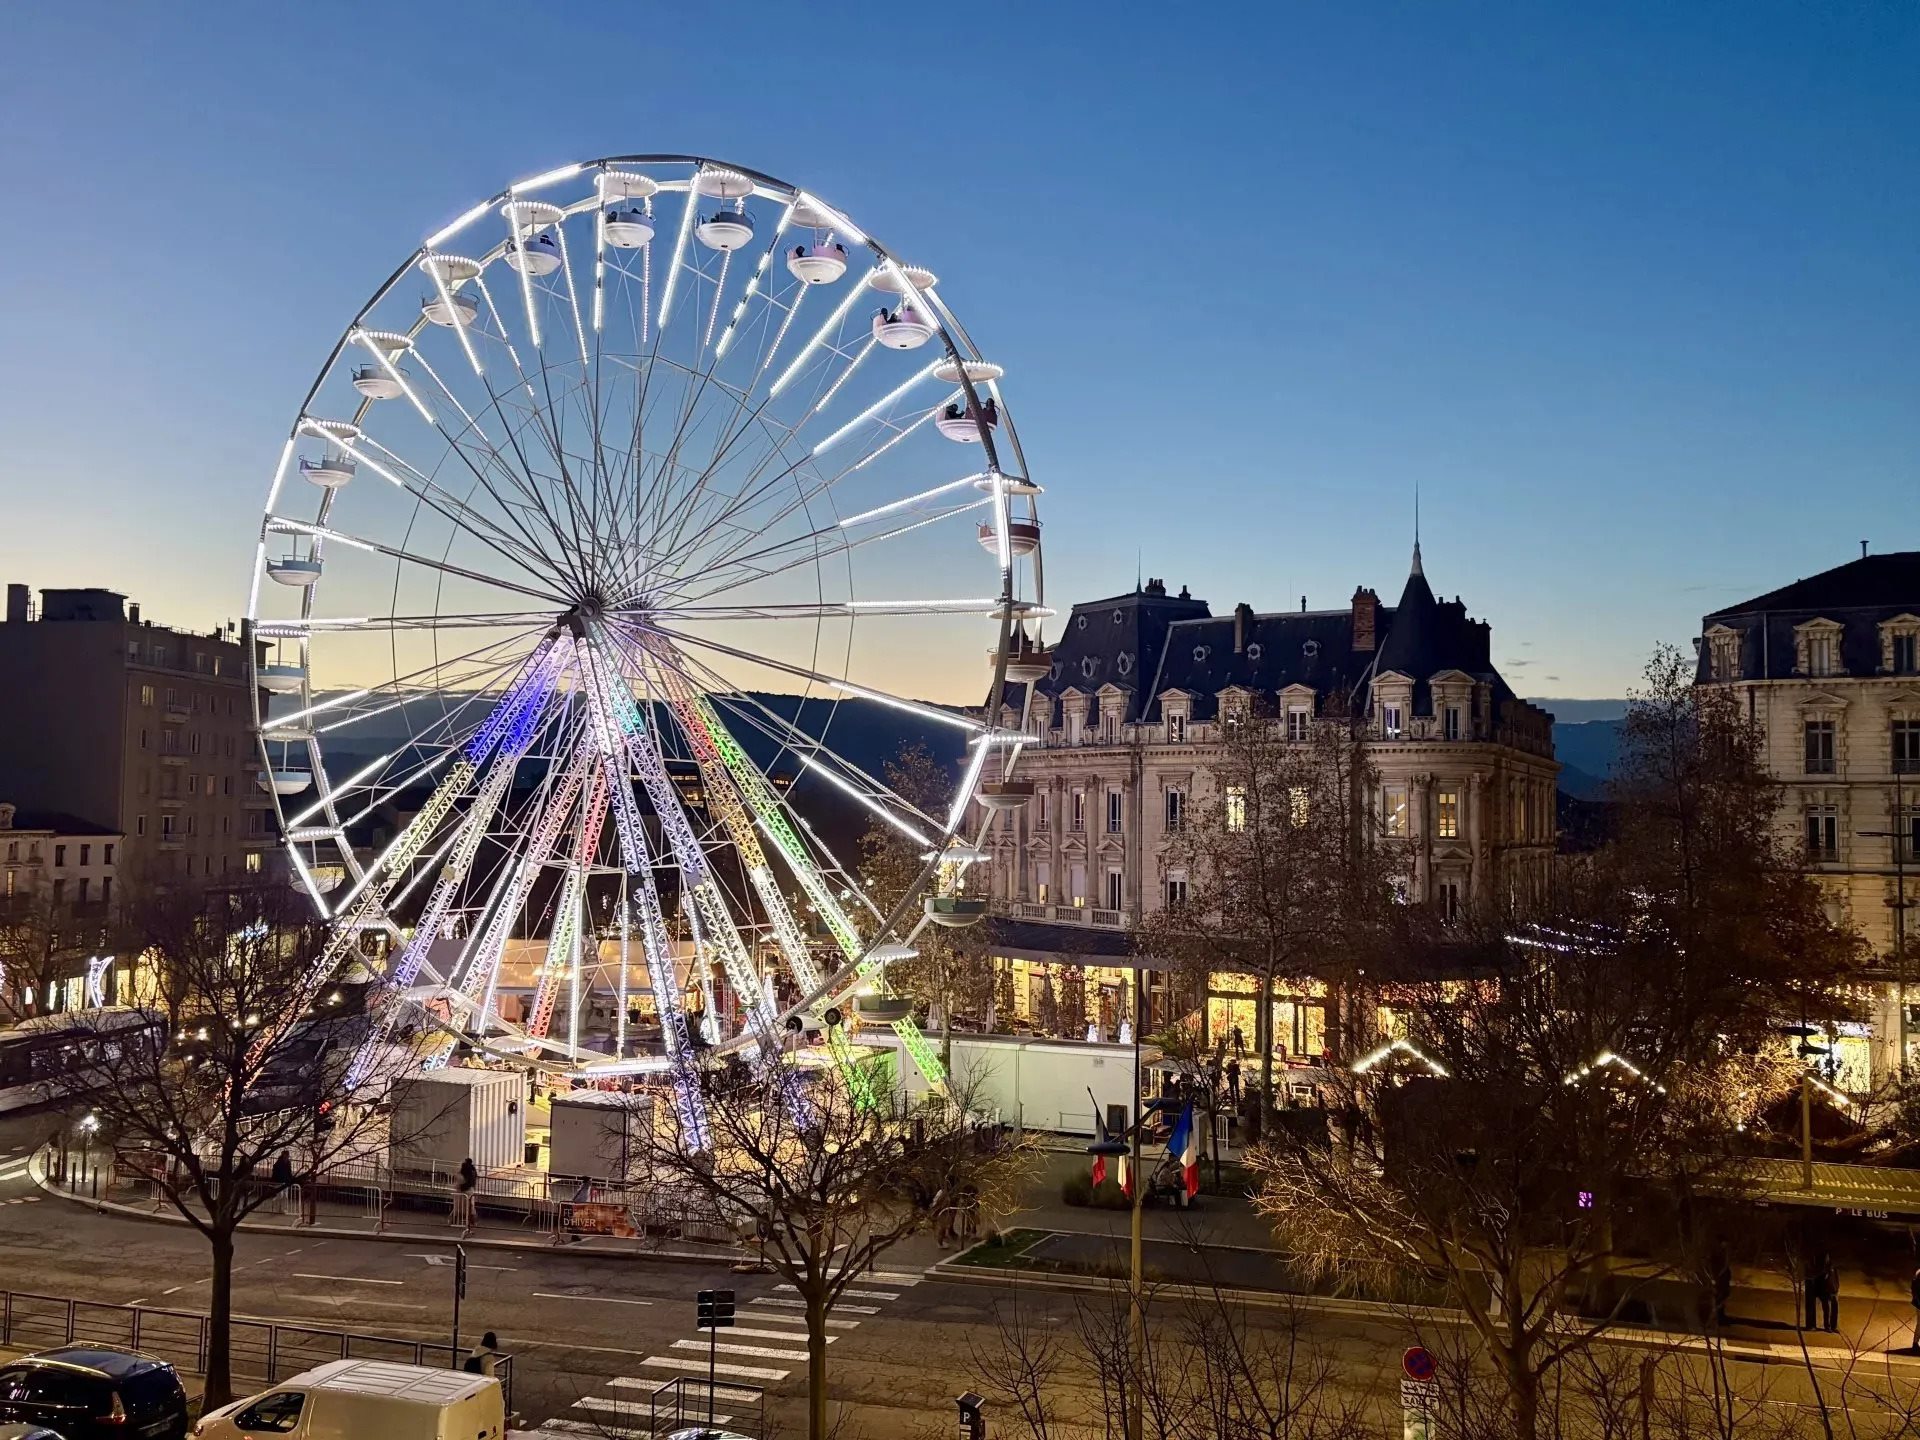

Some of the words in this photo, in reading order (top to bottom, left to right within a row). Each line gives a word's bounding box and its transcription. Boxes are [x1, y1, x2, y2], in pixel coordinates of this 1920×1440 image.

[1835, 1207, 1863, 1217] PLE
[1866, 1209, 1888, 1219] BUS
[563, 1217, 596, 1227] D'HIVER
[963, 1411, 970, 1422] P
